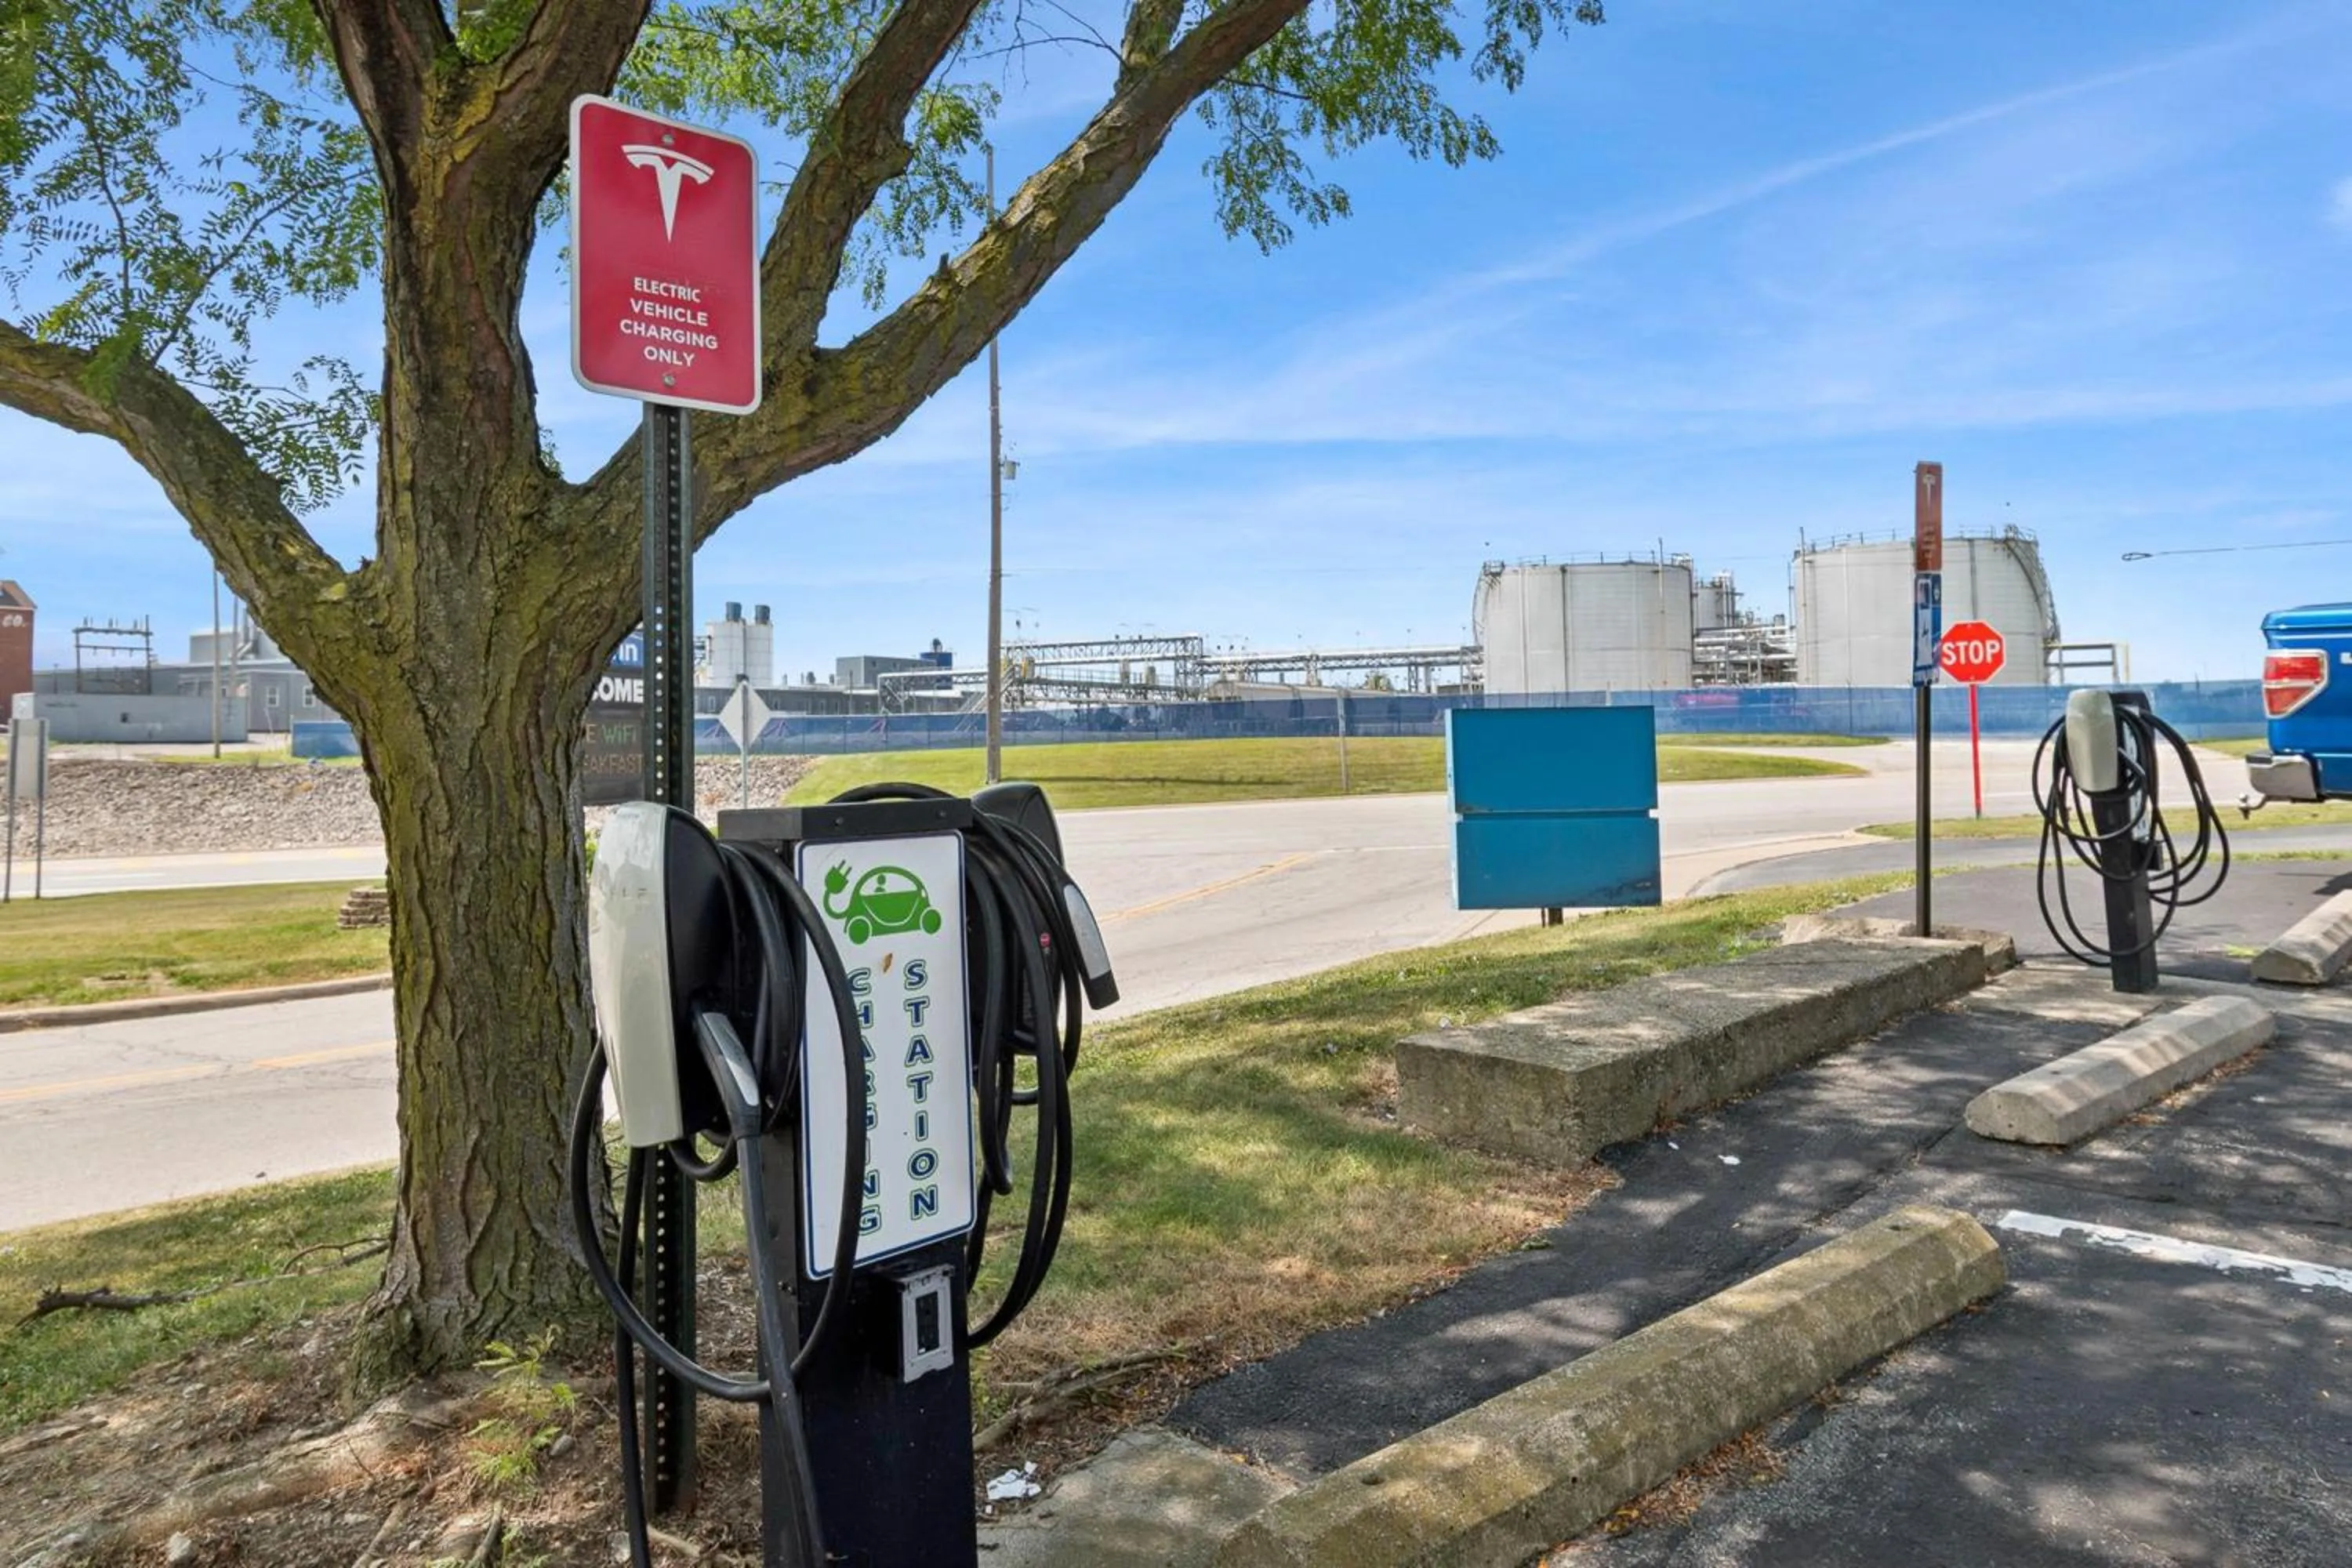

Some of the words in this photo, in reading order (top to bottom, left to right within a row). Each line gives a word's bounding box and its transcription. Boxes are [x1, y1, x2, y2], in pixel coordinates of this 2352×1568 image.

[634, 278, 701, 302] ELECTRIC
[630, 299, 708, 326] VEHICLE
[620, 319, 718, 349] CHARGING
[644, 346, 695, 366] ONLY
[1943, 640, 2000, 665] STOP
[592, 676, 644, 702] OME
[847, 967, 881, 1236] CHNG
[904, 959, 939, 1220] STATION
